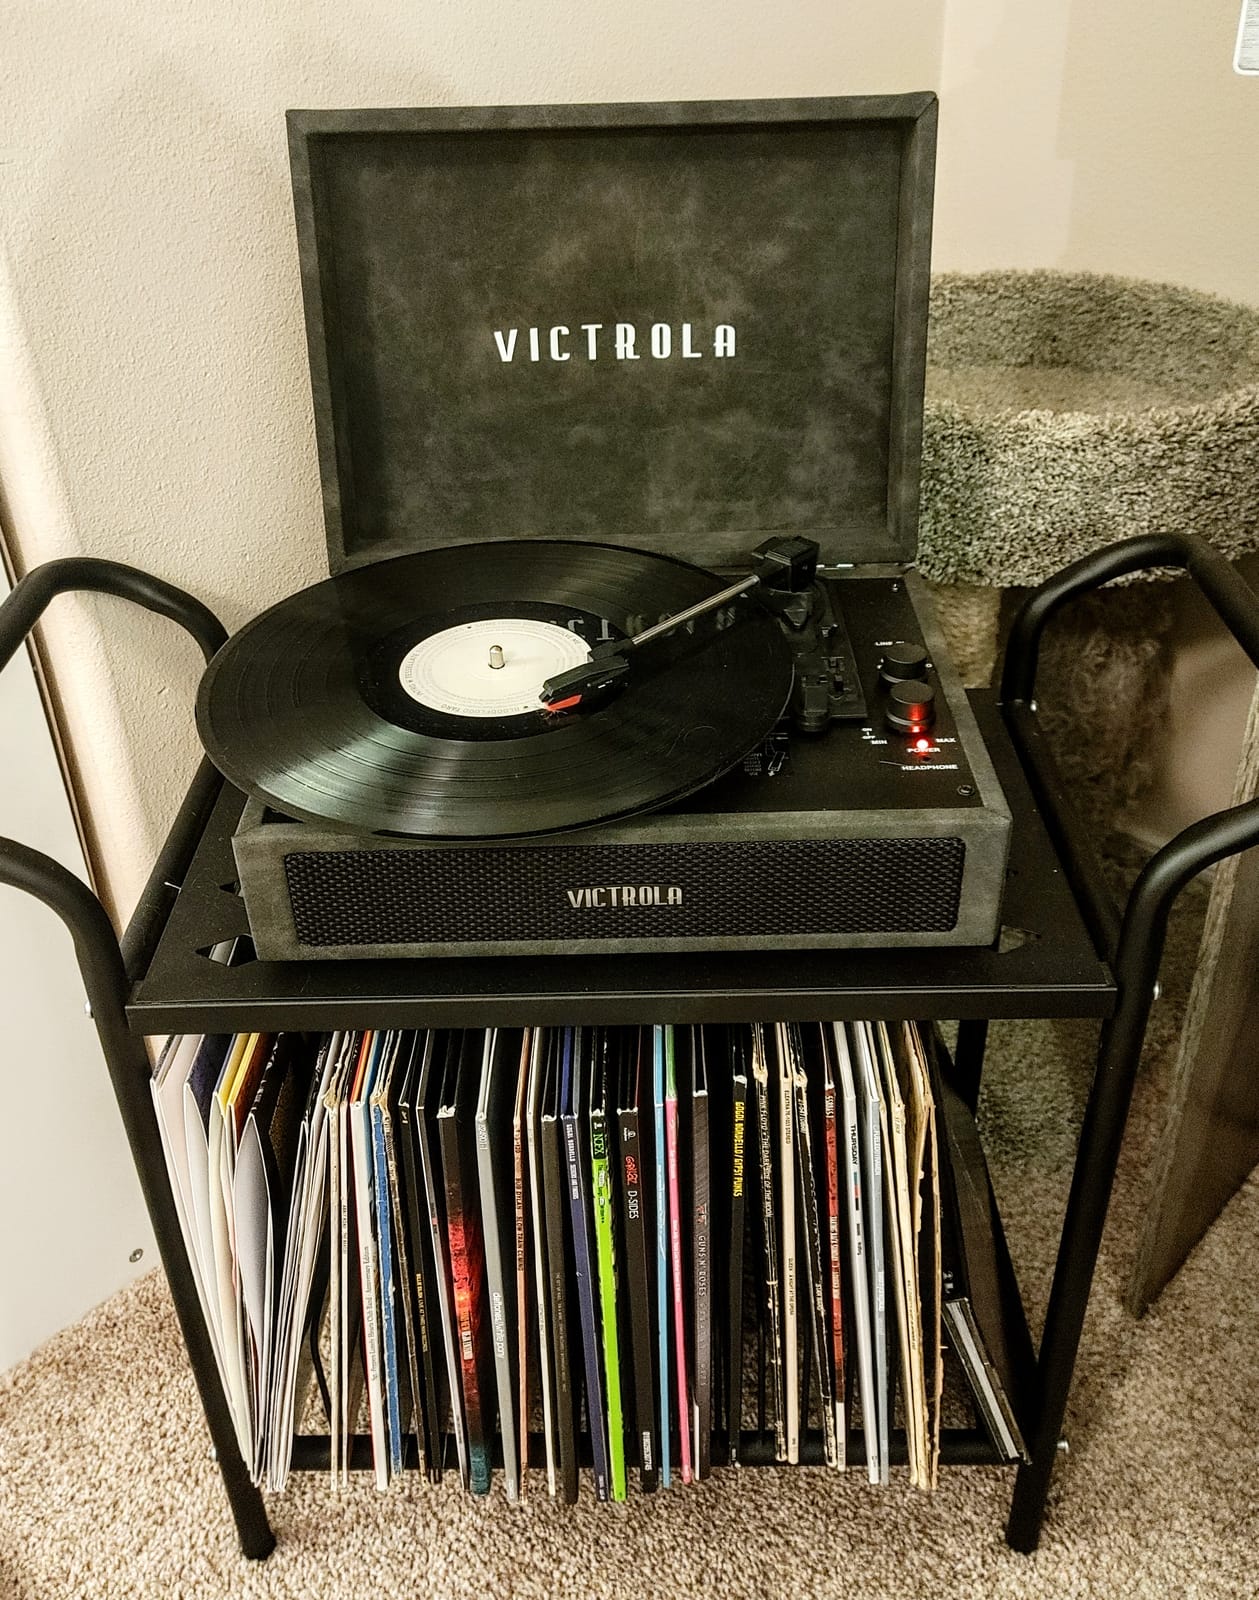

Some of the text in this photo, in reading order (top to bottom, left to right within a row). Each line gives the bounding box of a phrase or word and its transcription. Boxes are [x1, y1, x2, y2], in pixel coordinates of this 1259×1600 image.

[493, 322, 736, 362] VICTROLA
[567, 886, 683, 908] VICTROLA
[735, 1101, 745, 1122] GOGOL
[568, 1139, 576, 1162] BORDELLO
[593, 1133, 604, 1155] NOFX
[850, 1124, 858, 1165] THURSDAY
[733, 1158, 743, 1177] GYPSY
[733, 1177, 743, 1197] PUNKS
[763, 1180, 770, 1188] OF
[627, 1190, 639, 1219] D-SIDES
[764, 1190, 772, 1201] THE
[765, 1201, 773, 1218] MOON
[698, 1235, 706, 1257] GUNS
[698, 1260, 706, 1268] N'
[698, 1271, 706, 1297] ROSES
[495, 1342, 505, 1359] pony
